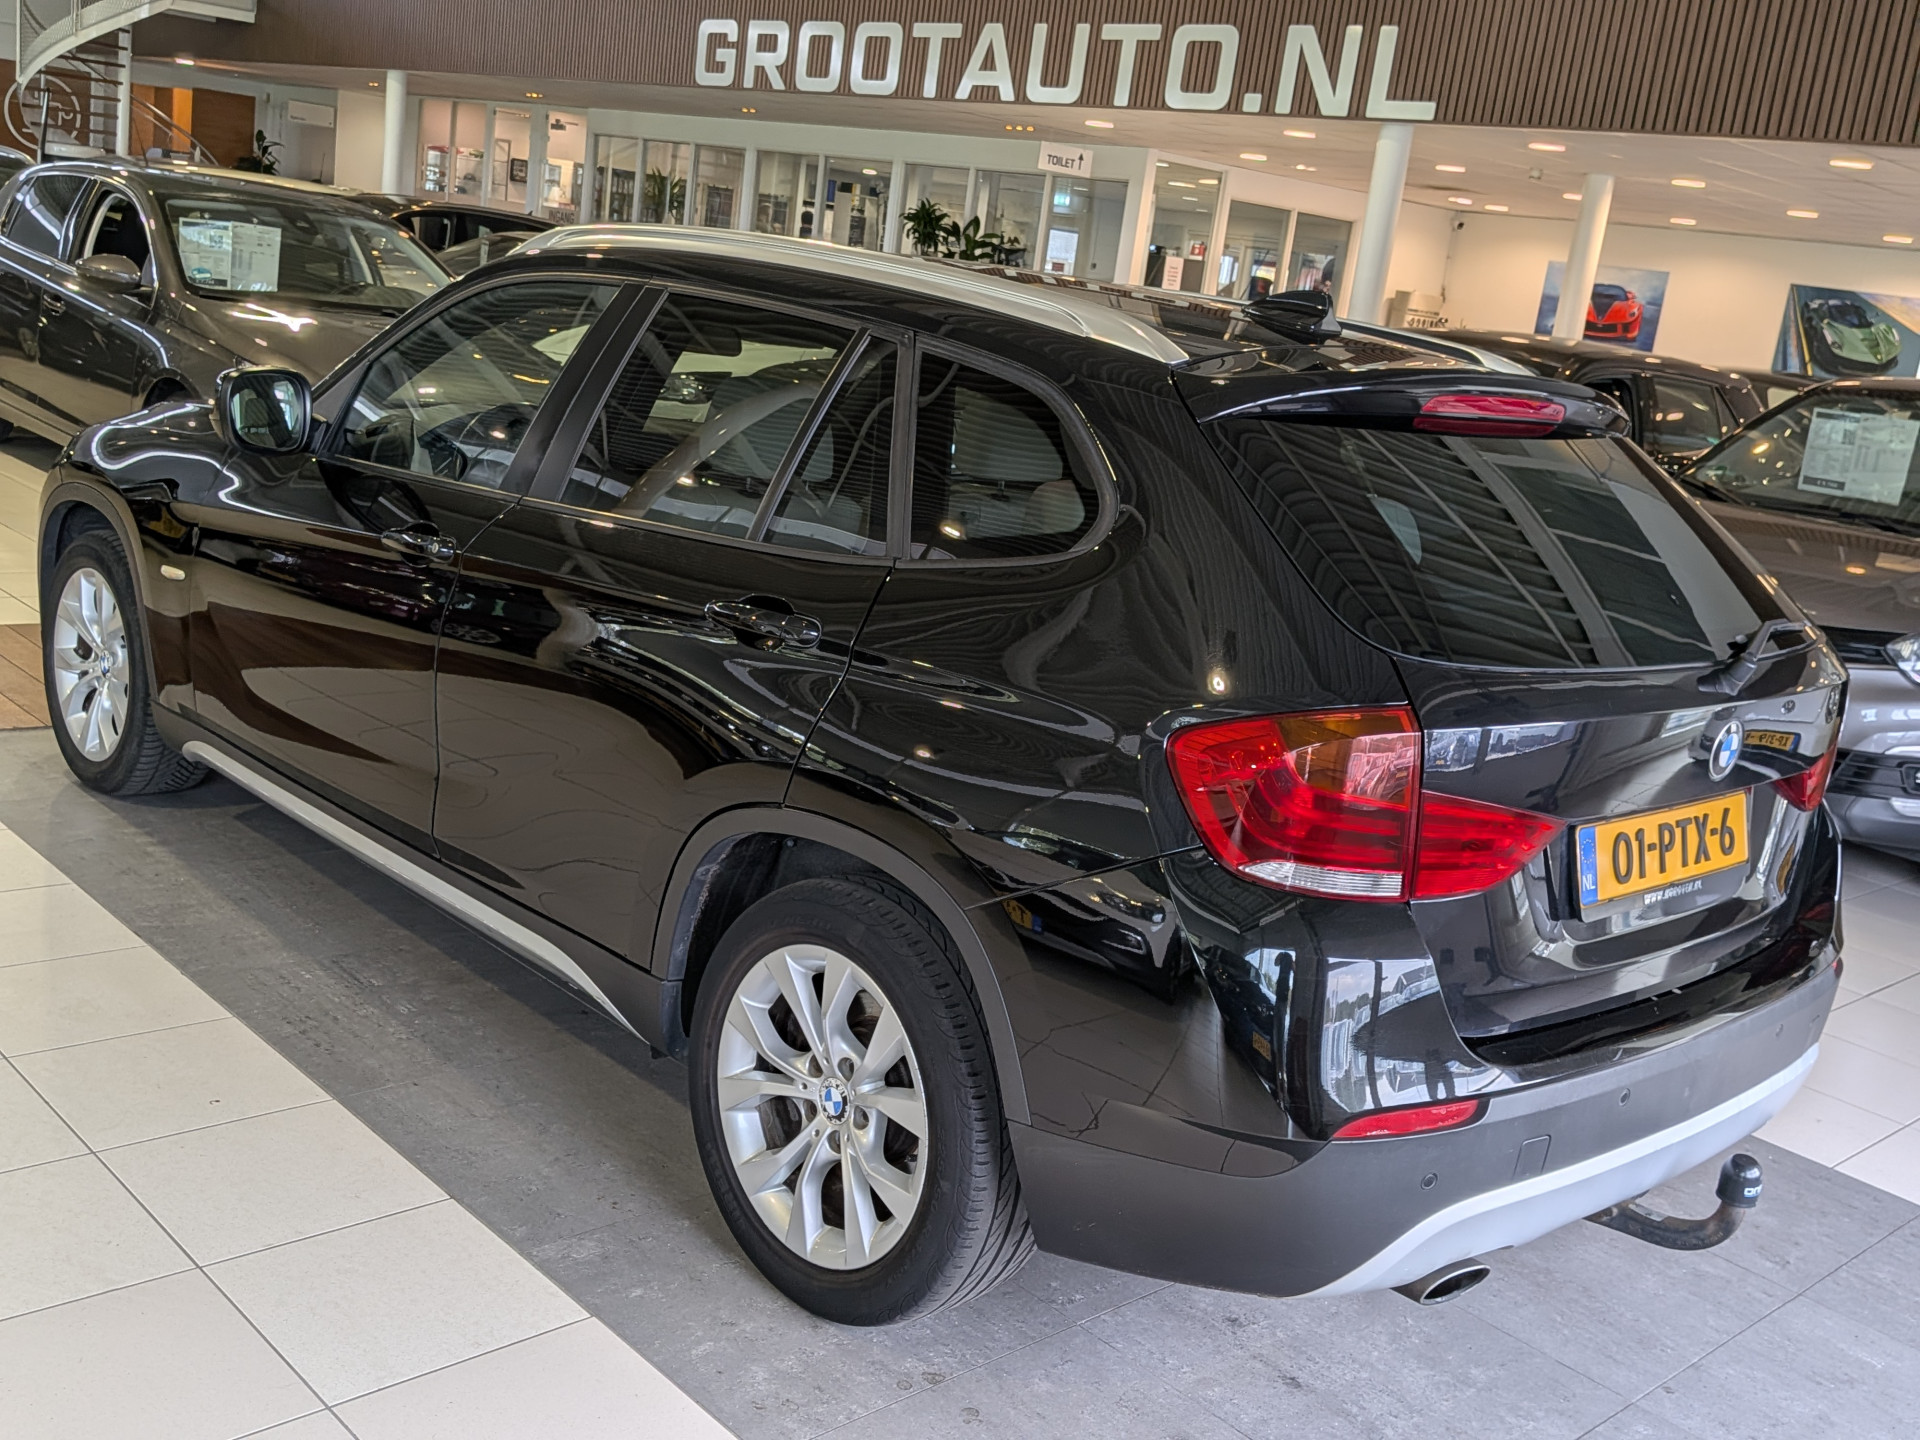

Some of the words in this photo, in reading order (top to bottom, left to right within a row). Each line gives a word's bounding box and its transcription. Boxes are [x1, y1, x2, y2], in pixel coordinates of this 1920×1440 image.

[695, 19, 1437, 121] GROOTAUTO.NL
[1047, 154, 1075, 169] TOILET
[549, 210, 575, 225] INGANG
[1612, 807, 1736, 885] 01-PTX-6
[1582, 873, 1596, 891] NL
